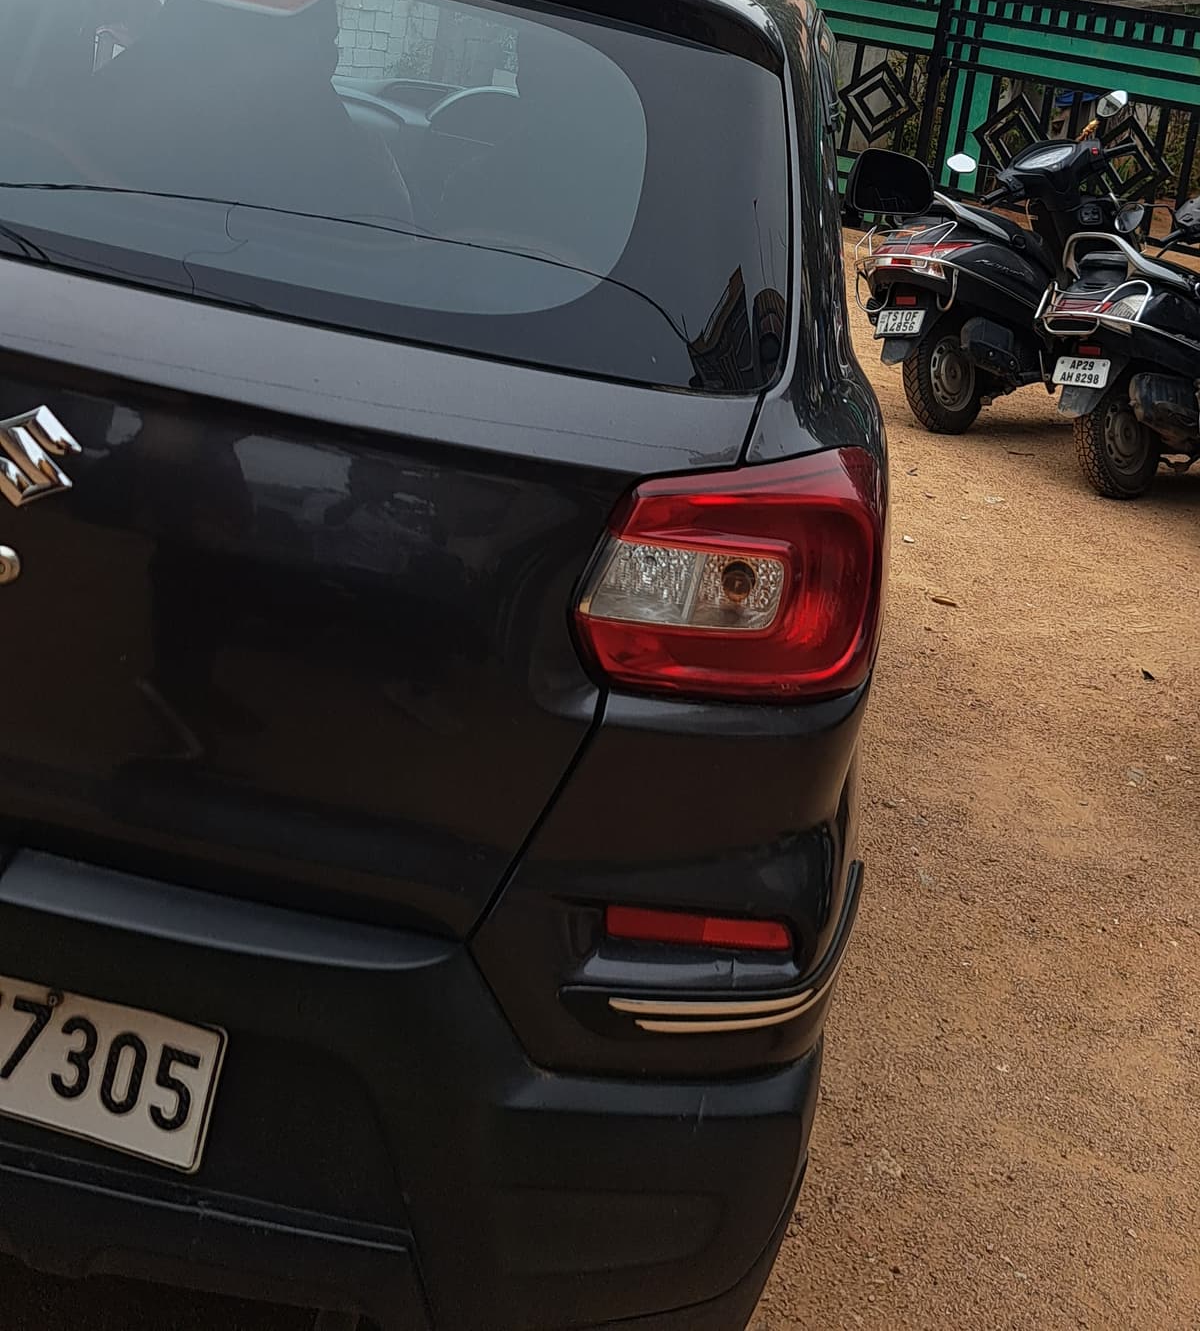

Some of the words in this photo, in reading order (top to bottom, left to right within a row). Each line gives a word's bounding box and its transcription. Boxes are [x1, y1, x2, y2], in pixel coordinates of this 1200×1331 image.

[1069, 359, 1095, 371] AP29
[1060, 371, 1074, 382] AH
[1074, 372, 1100, 385] 8298
[0, 988, 201, 1131] 7305
